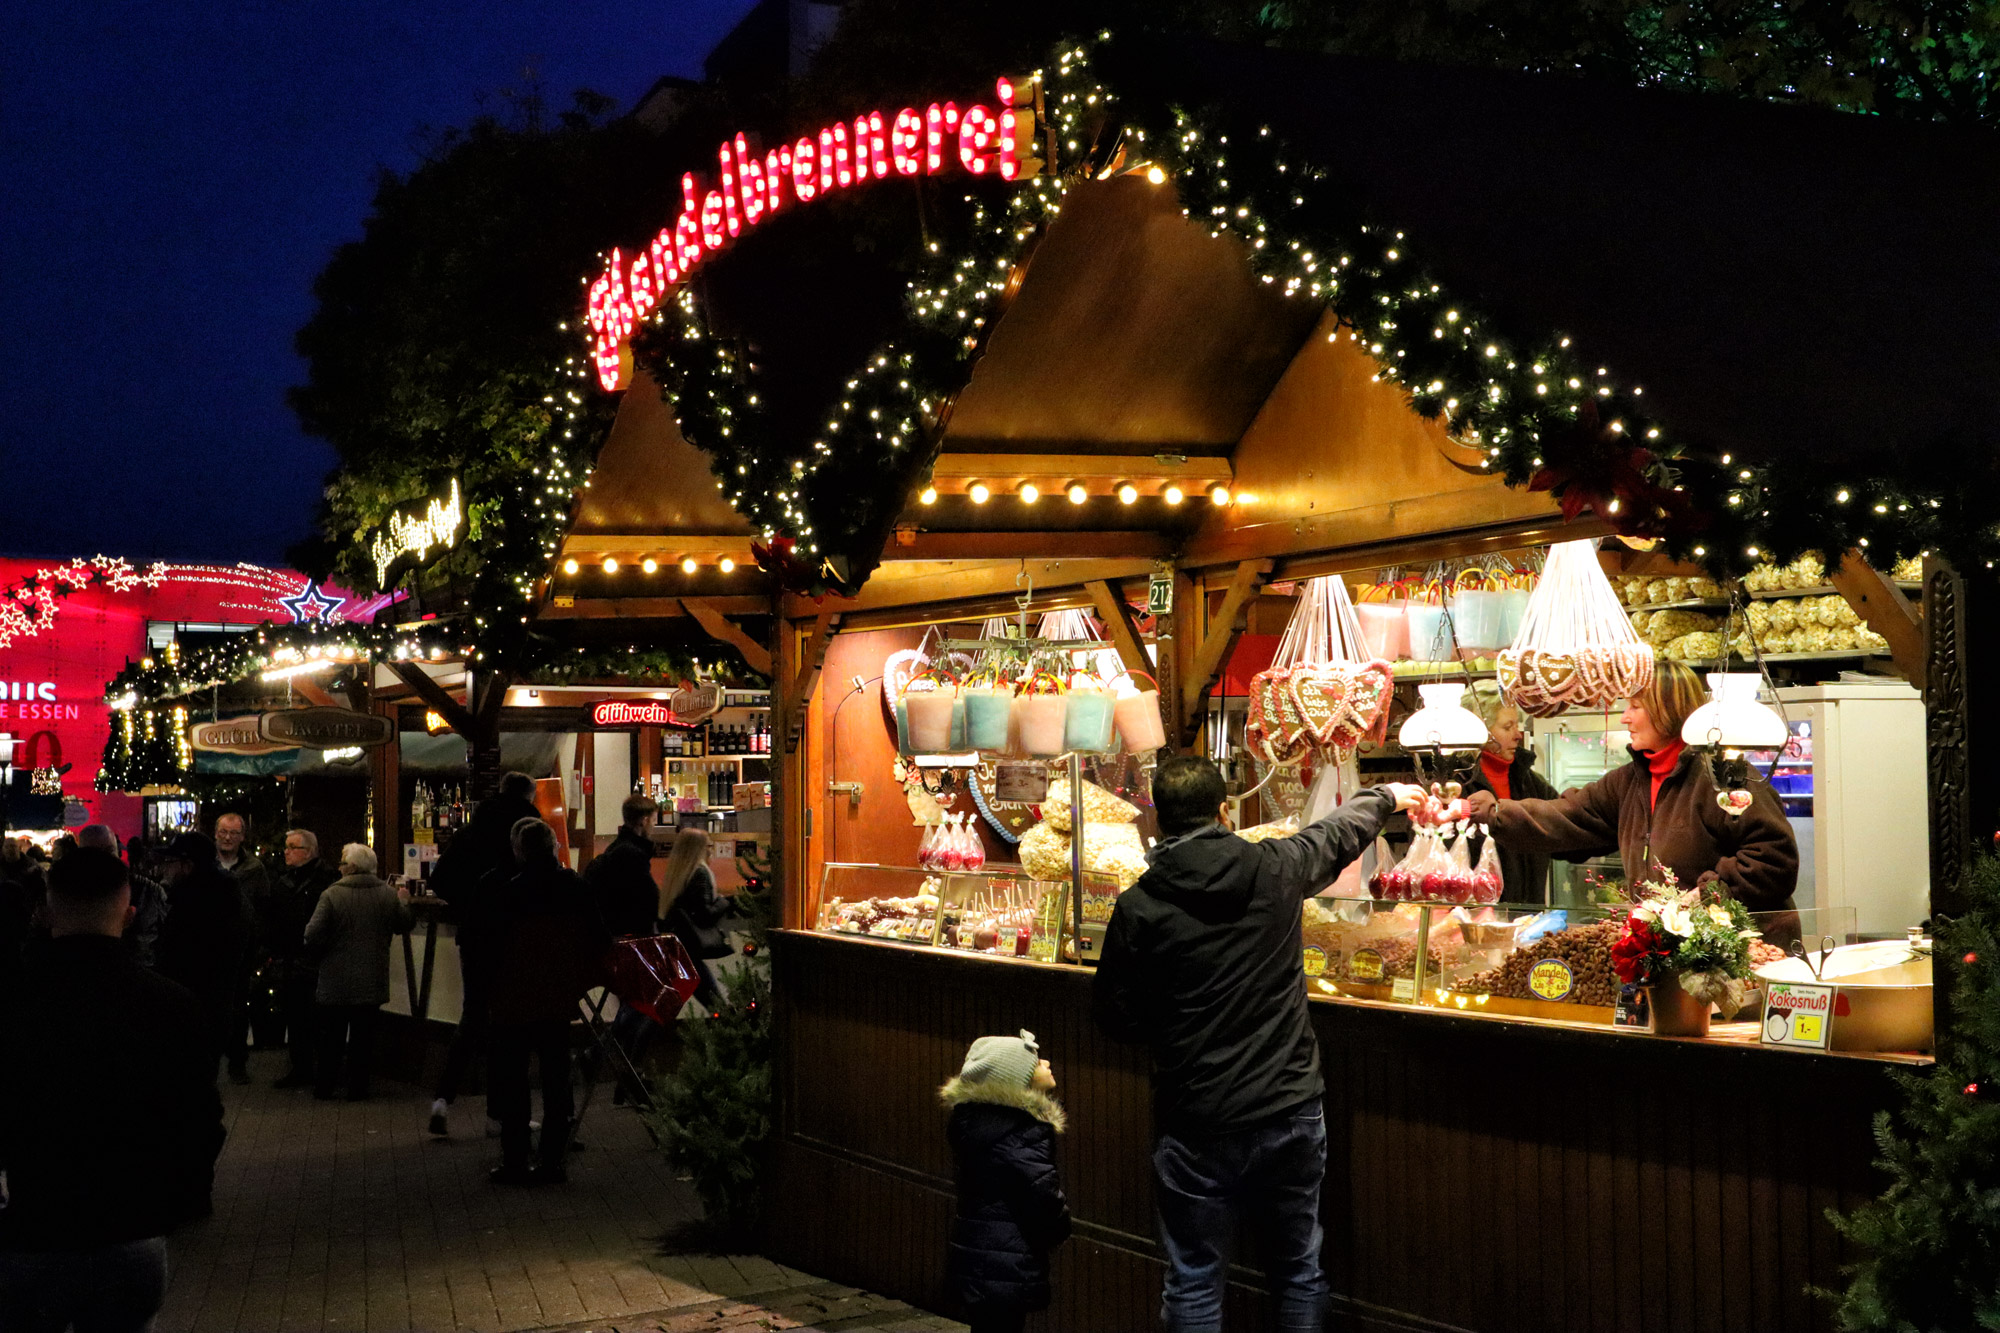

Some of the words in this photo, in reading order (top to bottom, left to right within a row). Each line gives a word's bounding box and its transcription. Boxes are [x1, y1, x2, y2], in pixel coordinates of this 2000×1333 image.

[588, 76, 1022, 392] Mandelbrennerei
[1303, 684, 1322, 696] Ich
[1303, 697, 1329, 708] liebe
[19, 704, 79, 720] ESSEN
[596, 703, 668, 724] Glühwein
[1307, 708, 1331, 717] Dich
[1533, 966, 1569, 981] Mandeln
[1768, 992, 1827, 1010] Kokosnuß
